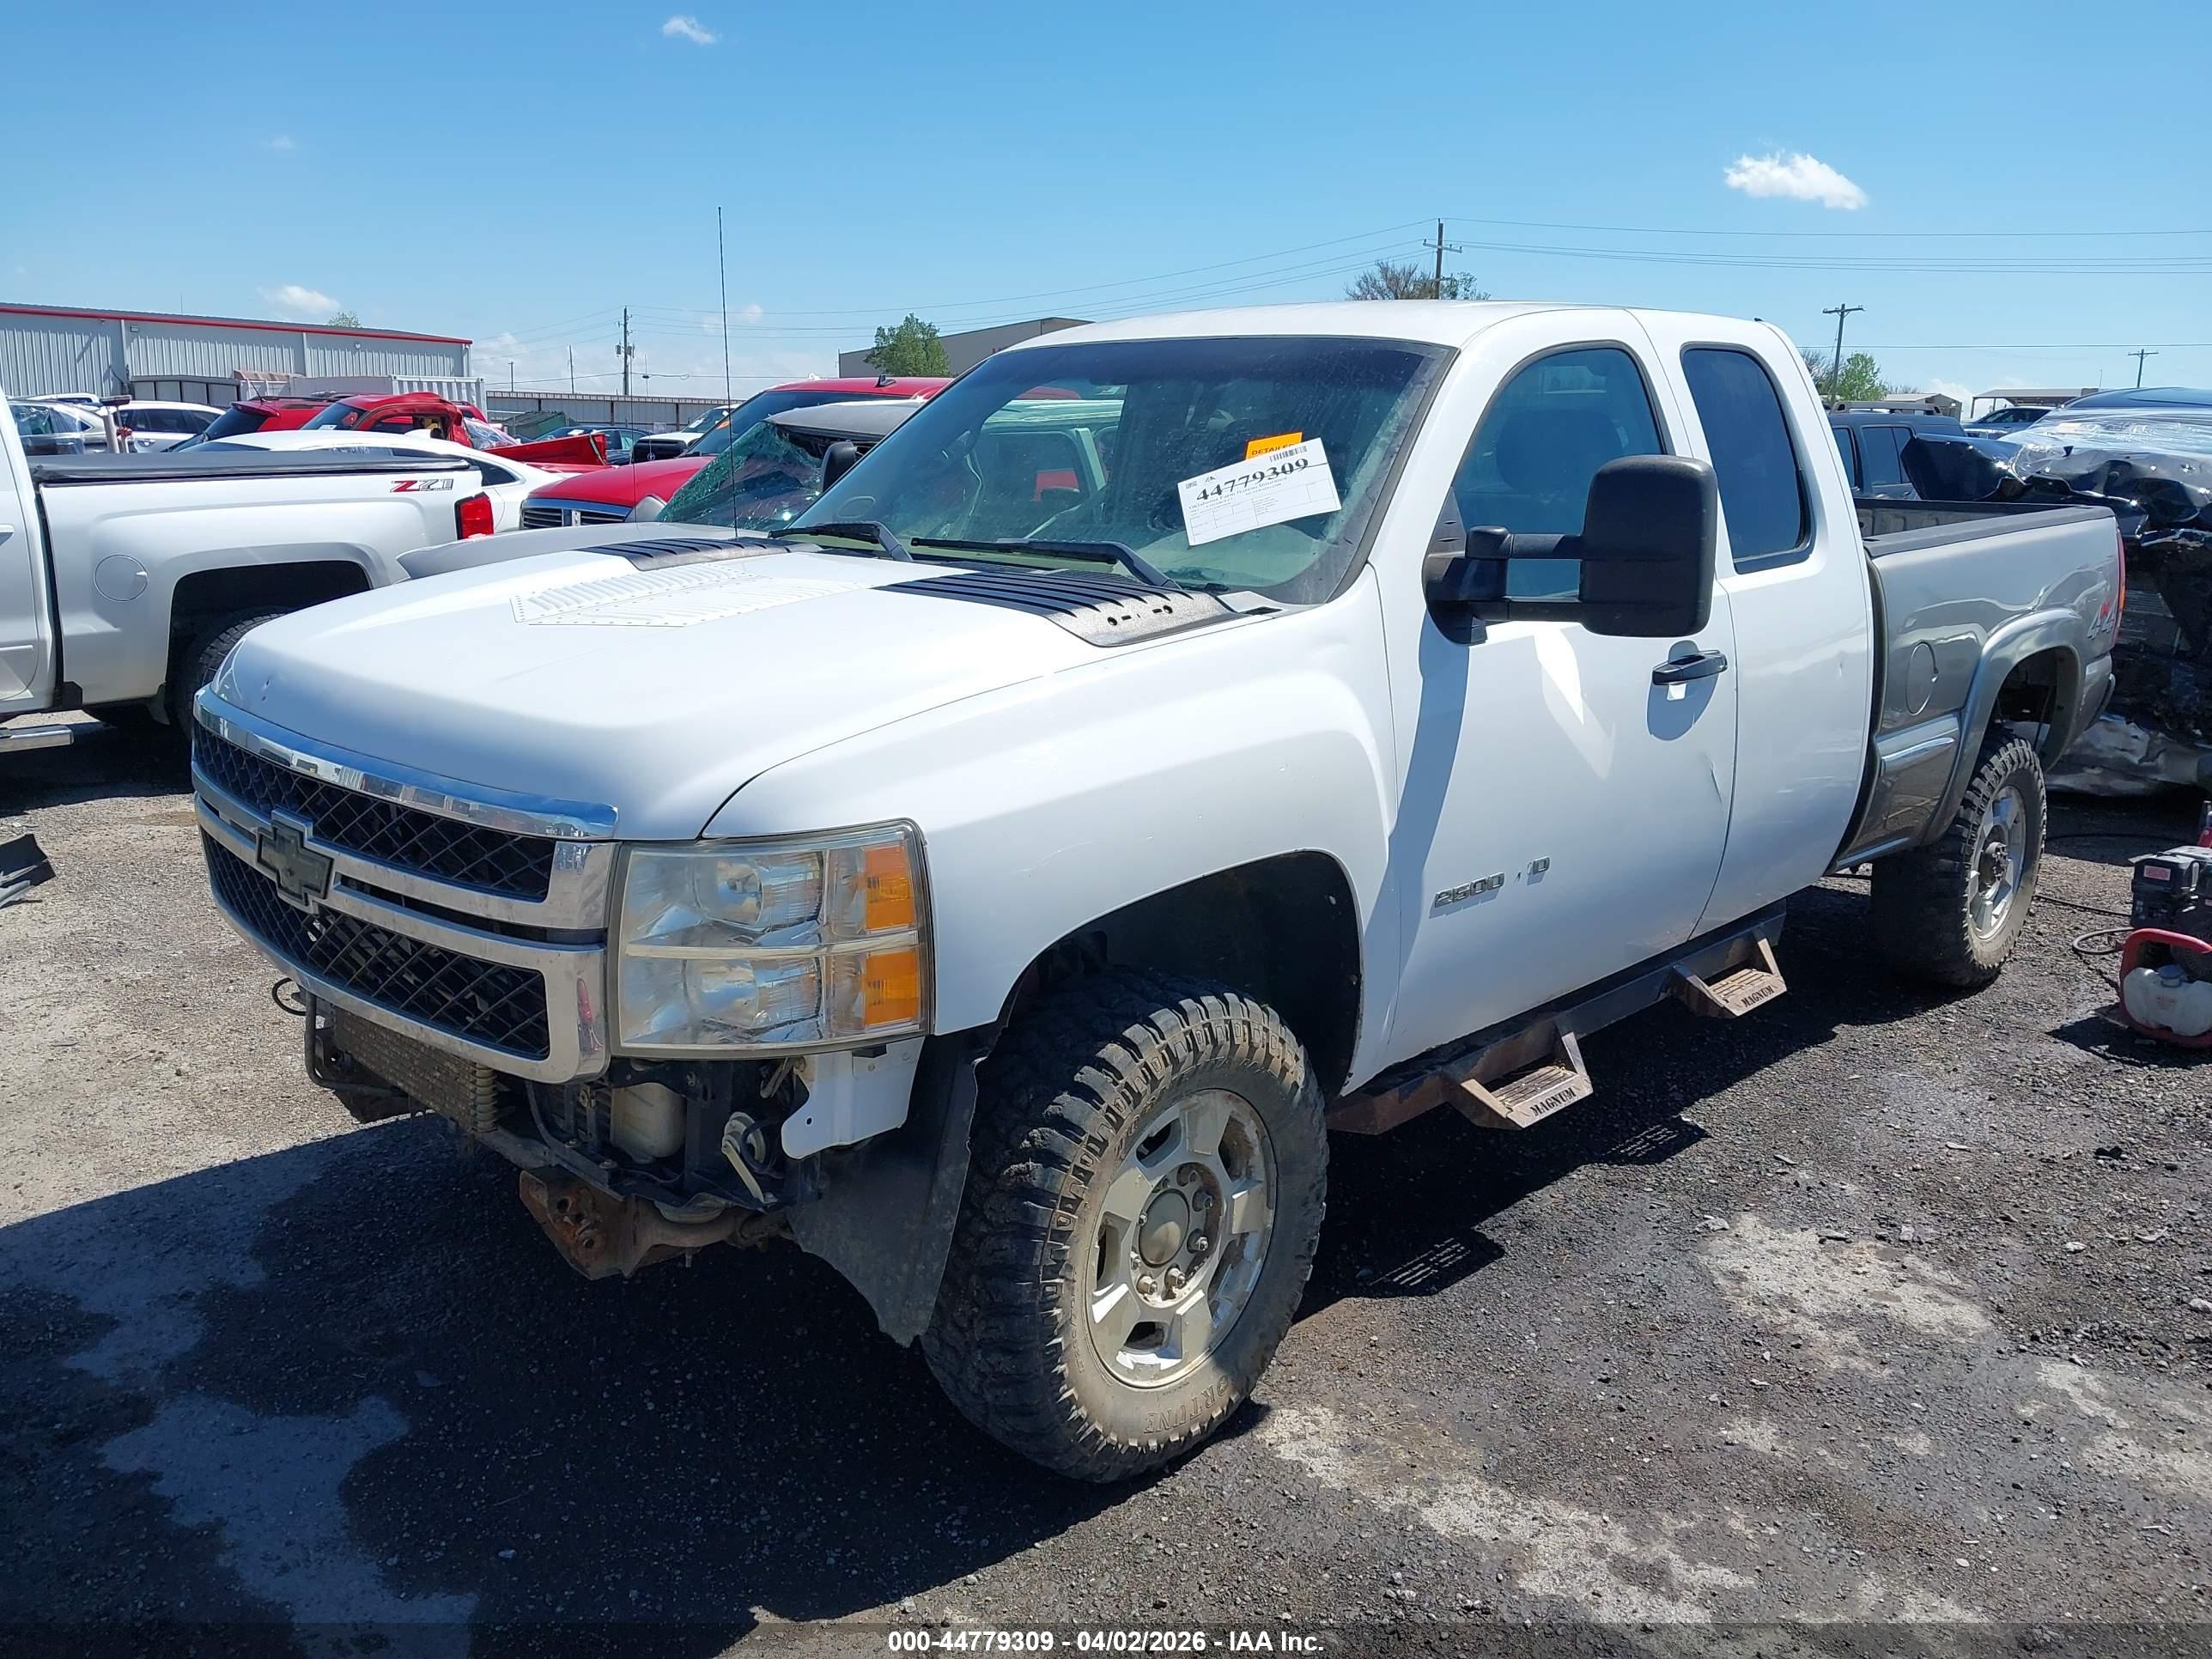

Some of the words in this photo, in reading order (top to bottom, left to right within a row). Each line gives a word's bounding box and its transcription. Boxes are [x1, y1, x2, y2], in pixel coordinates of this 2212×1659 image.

[390, 478, 454, 493] Z71
[1196, 458, 1309, 501] 44779309
[1435, 872, 1505, 908] 2500
[1741, 985, 1775, 1008] MAGNUM
[1528, 1086, 1577, 1117] MAGNUM
